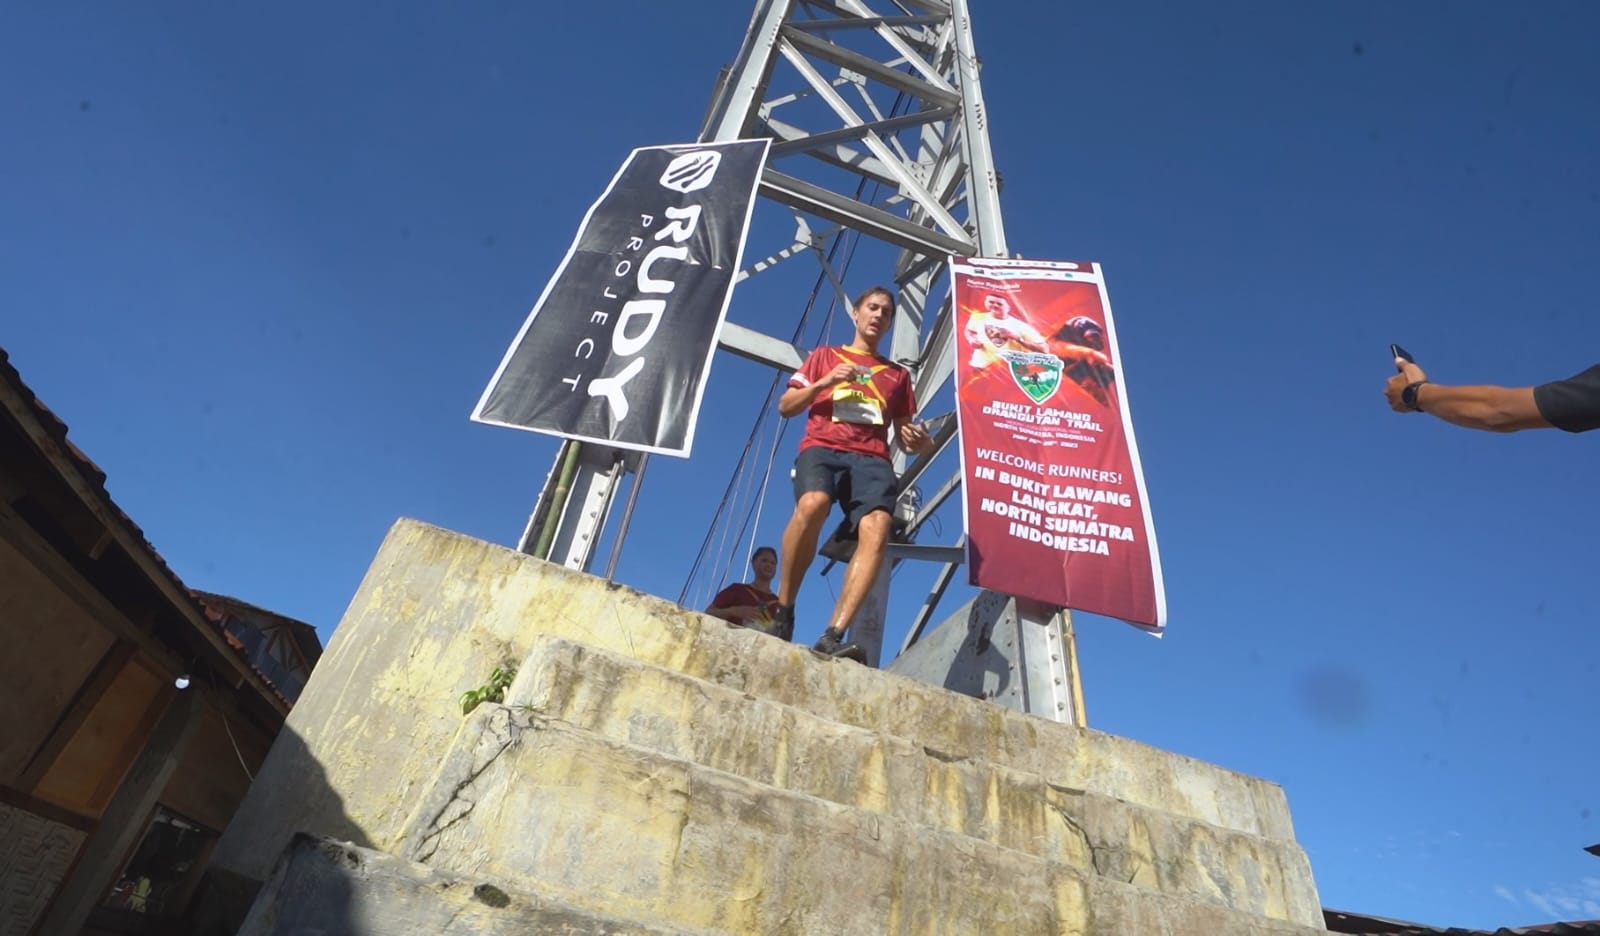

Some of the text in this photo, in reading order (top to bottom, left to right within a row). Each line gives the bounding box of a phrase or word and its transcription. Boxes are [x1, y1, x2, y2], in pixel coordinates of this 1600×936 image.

[562, 213, 653, 391] PROJECT
[588, 204, 702, 421] RUDY
[982, 405, 1061, 426] ORANGUTAN
[1067, 418, 1104, 432] TRAIL
[991, 400, 1091, 422] BUKIT LAWANG
[976, 447, 1123, 485] WELCOME RUNNERS!
[974, 465, 1132, 508] IN BUKIT LAWANG
[1011, 490, 1099, 520] LANGKAT,
[980, 497, 1135, 542] NORTH SUMATRA
[1008, 522, 1110, 556] INDONESIA
